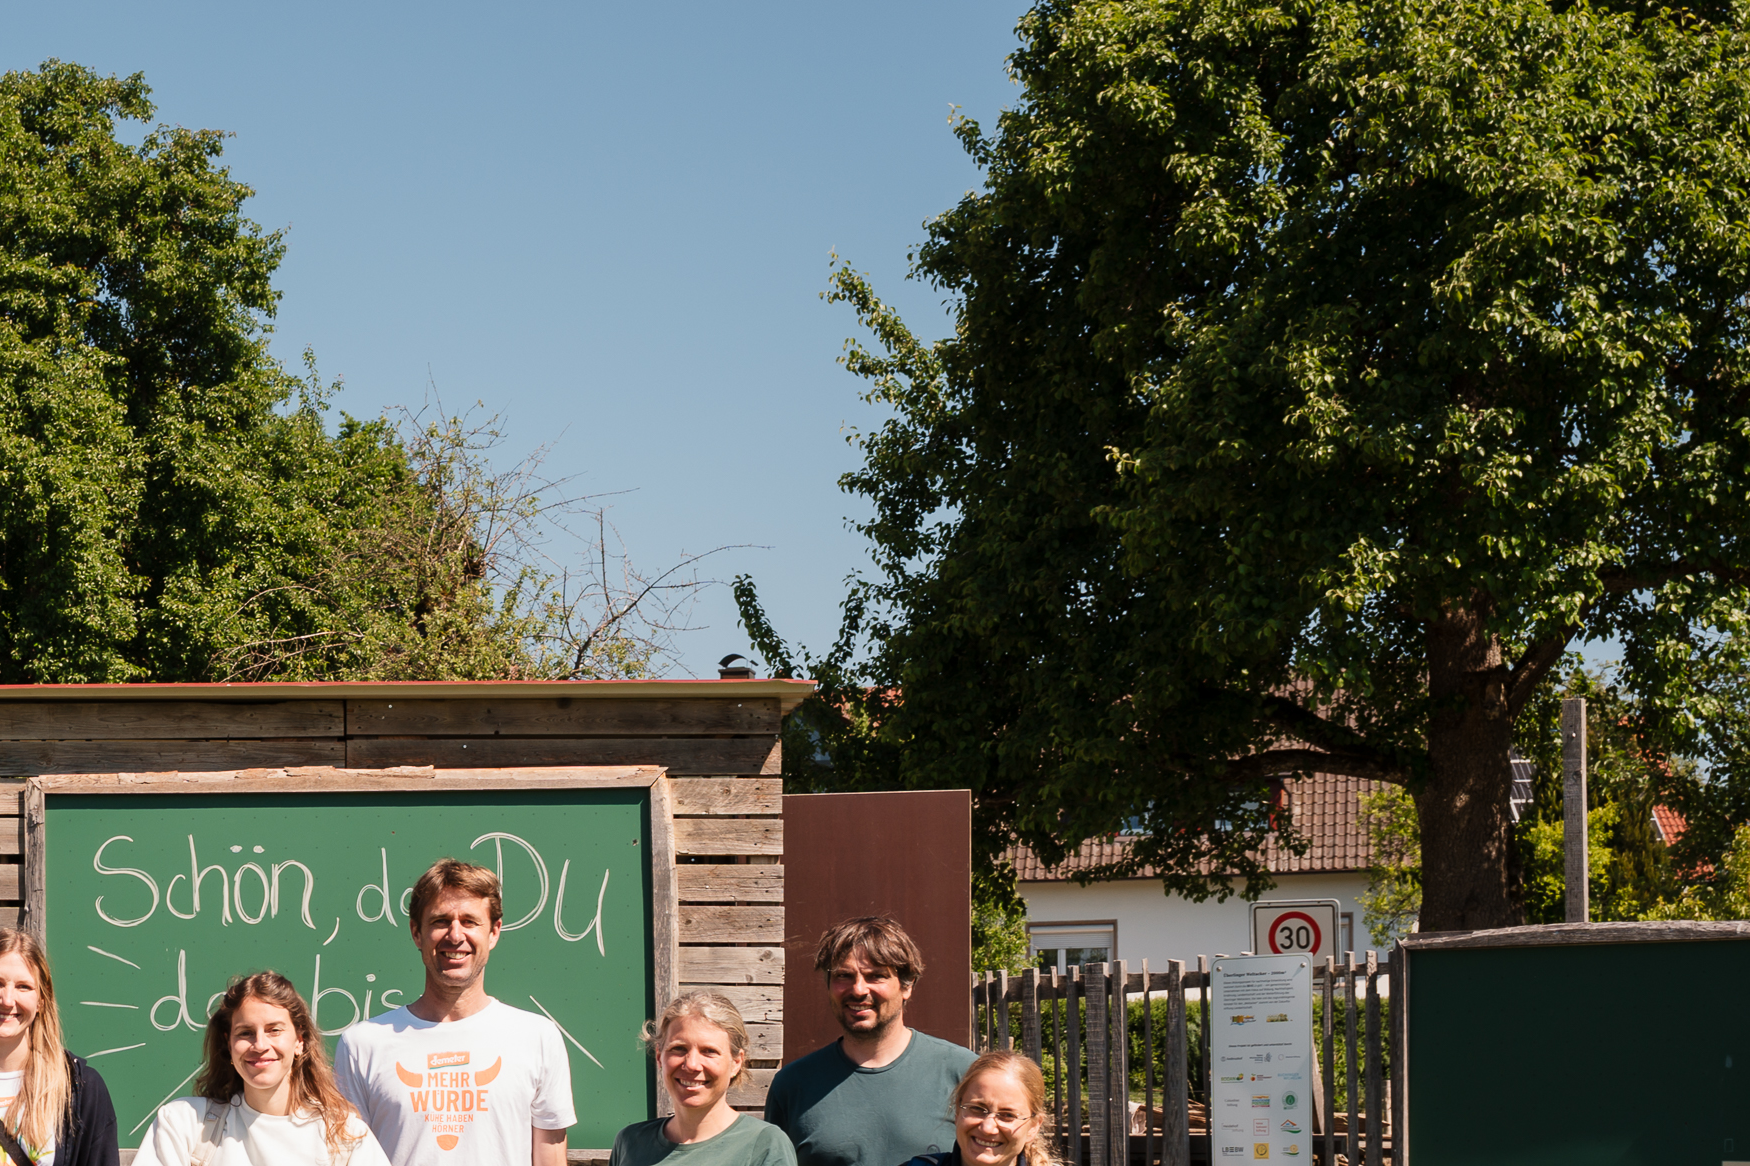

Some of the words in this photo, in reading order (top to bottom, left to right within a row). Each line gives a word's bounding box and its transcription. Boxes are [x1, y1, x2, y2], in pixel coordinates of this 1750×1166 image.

[94, 834, 340, 946] Schön,
[470, 832, 610, 957] Du
[1280, 926, 1310, 950] 30
[430, 1054, 466, 1066] demeter
[428, 1072, 470, 1088] MEHR
[410, 1090, 488, 1113] WÜRDE
[425, 1112, 444, 1122] KÜHE
[446, 1114, 473, 1122] HABEN
[432, 1123, 464, 1133] HÖRNER
